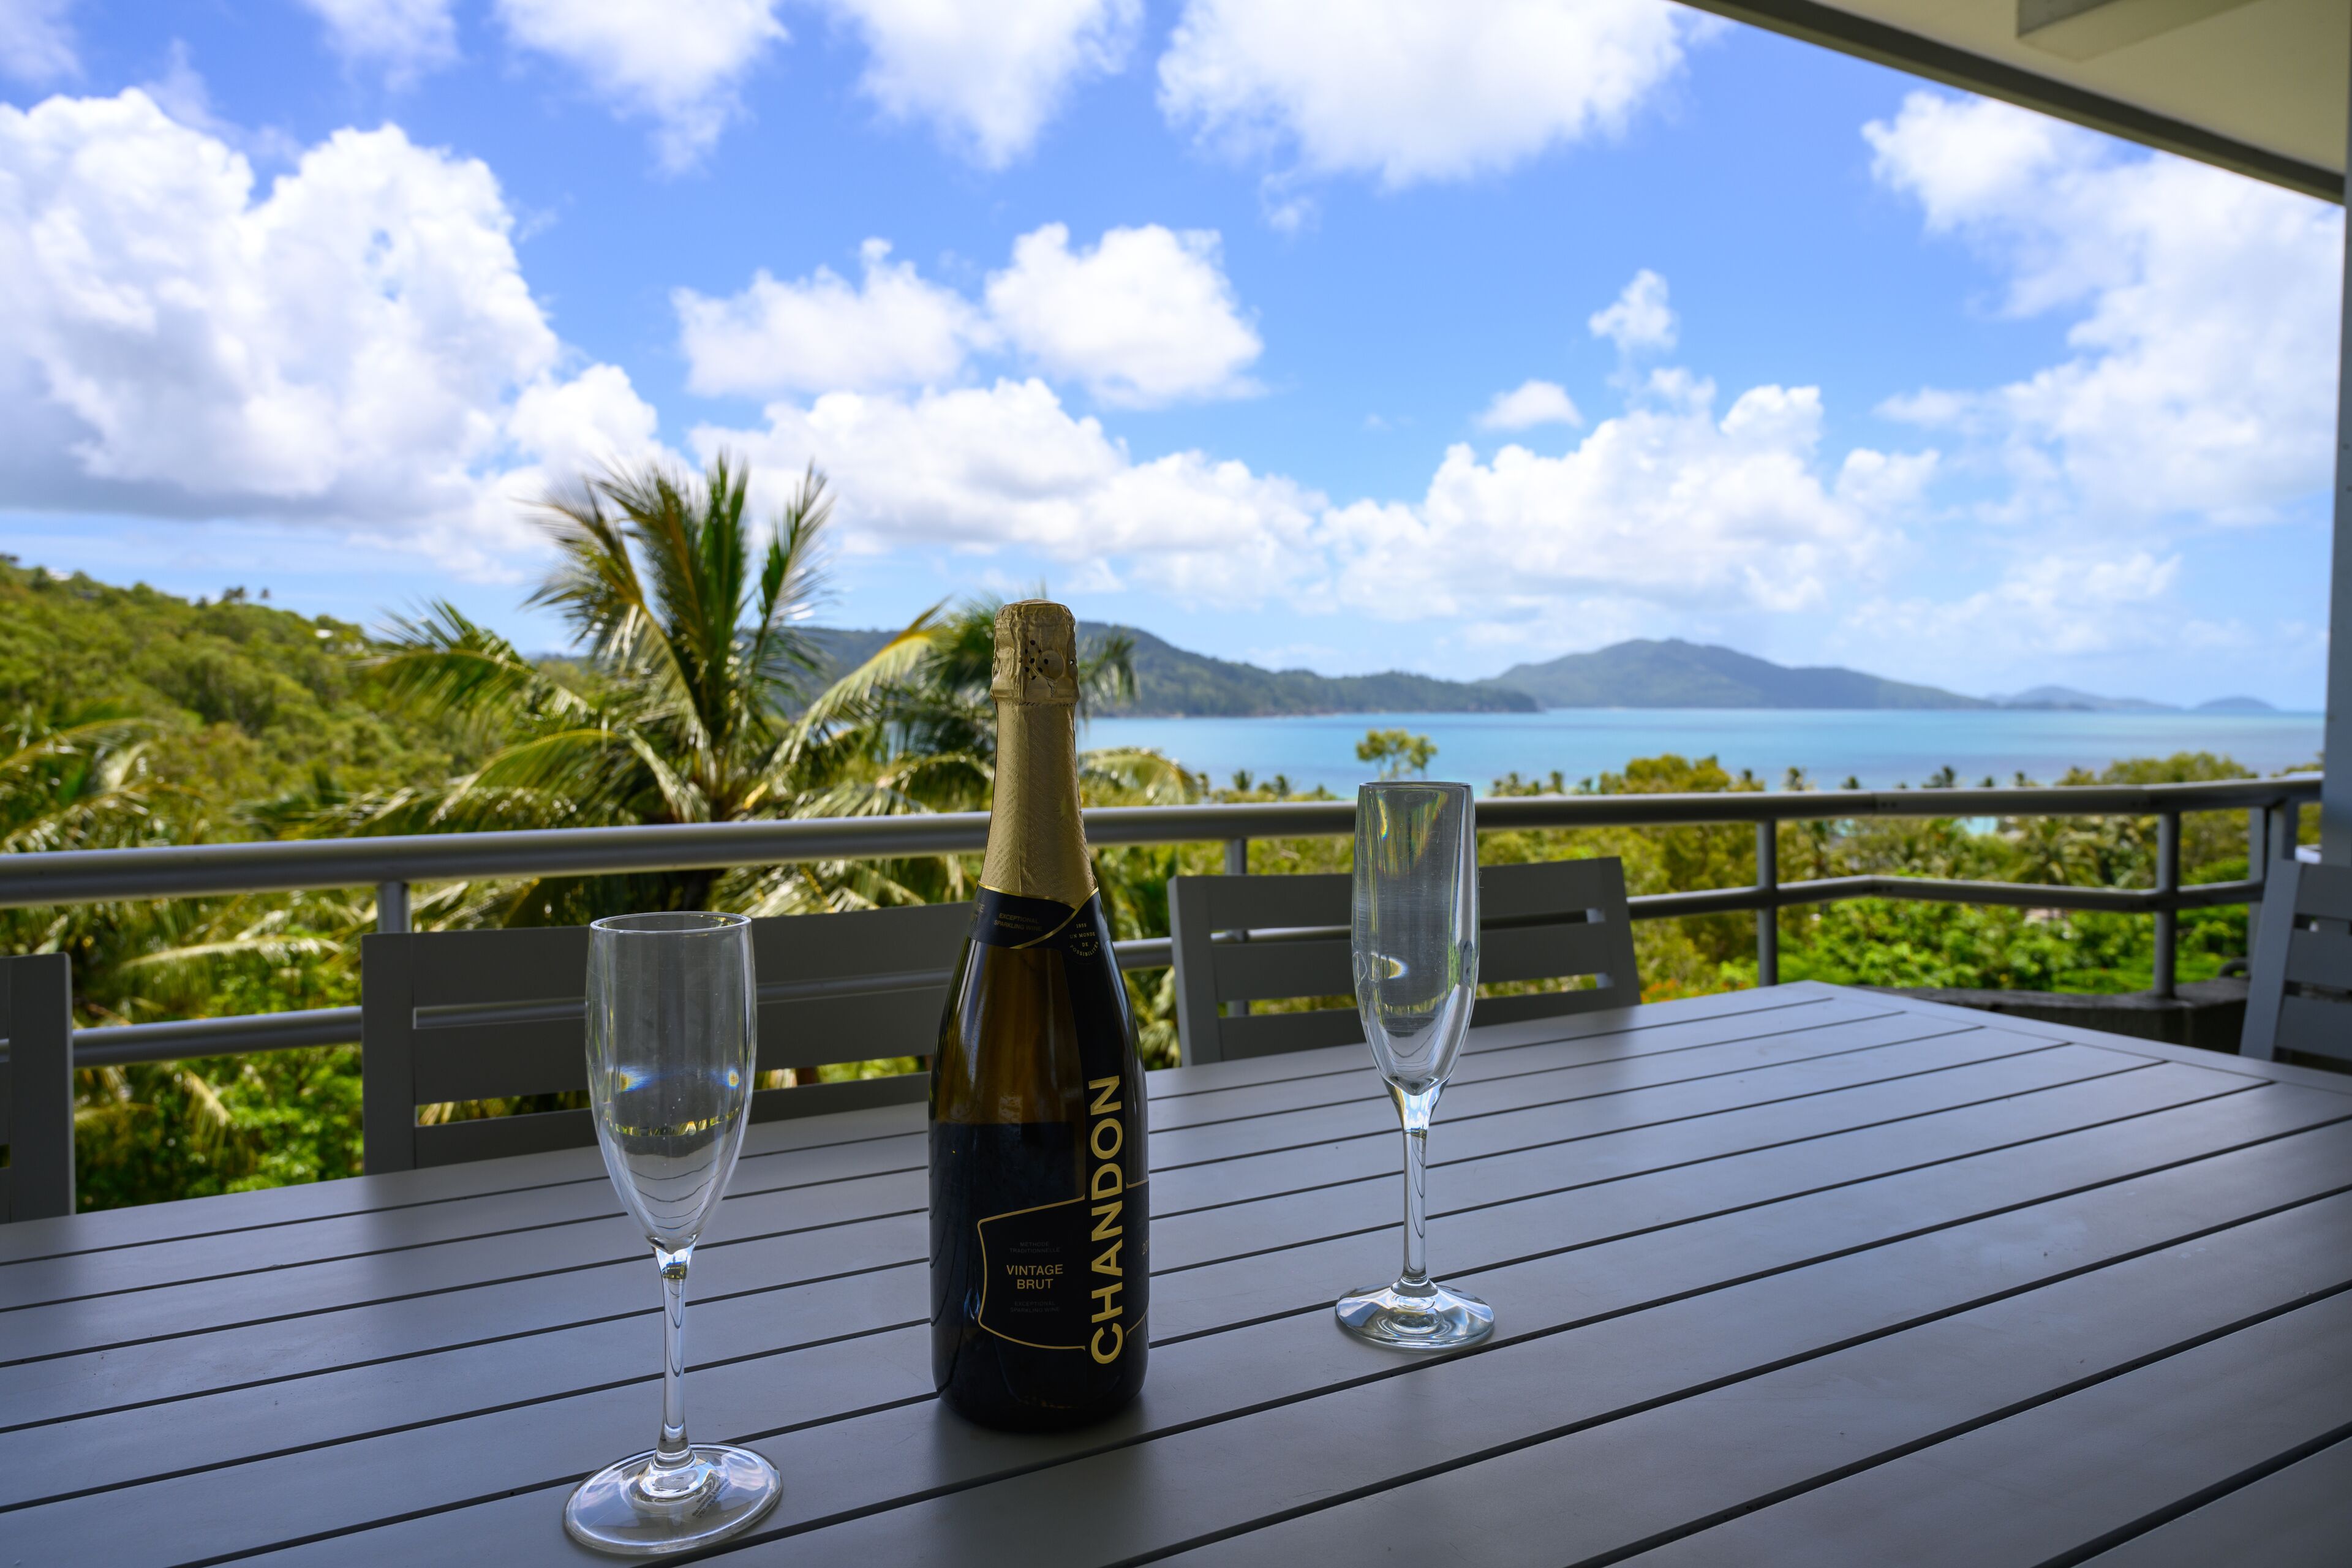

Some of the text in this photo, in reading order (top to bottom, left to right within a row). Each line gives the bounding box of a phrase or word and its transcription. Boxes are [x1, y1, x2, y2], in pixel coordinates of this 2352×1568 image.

[999, 913, 1039, 924] EXCEPTIONAL
[993, 919, 1025, 930] SPARKLING
[1088, 1075, 1123, 1365] CHANDON
[1006, 1264, 1063, 1276] VINTAGE
[1017, 1278, 1054, 1289] BRUT
